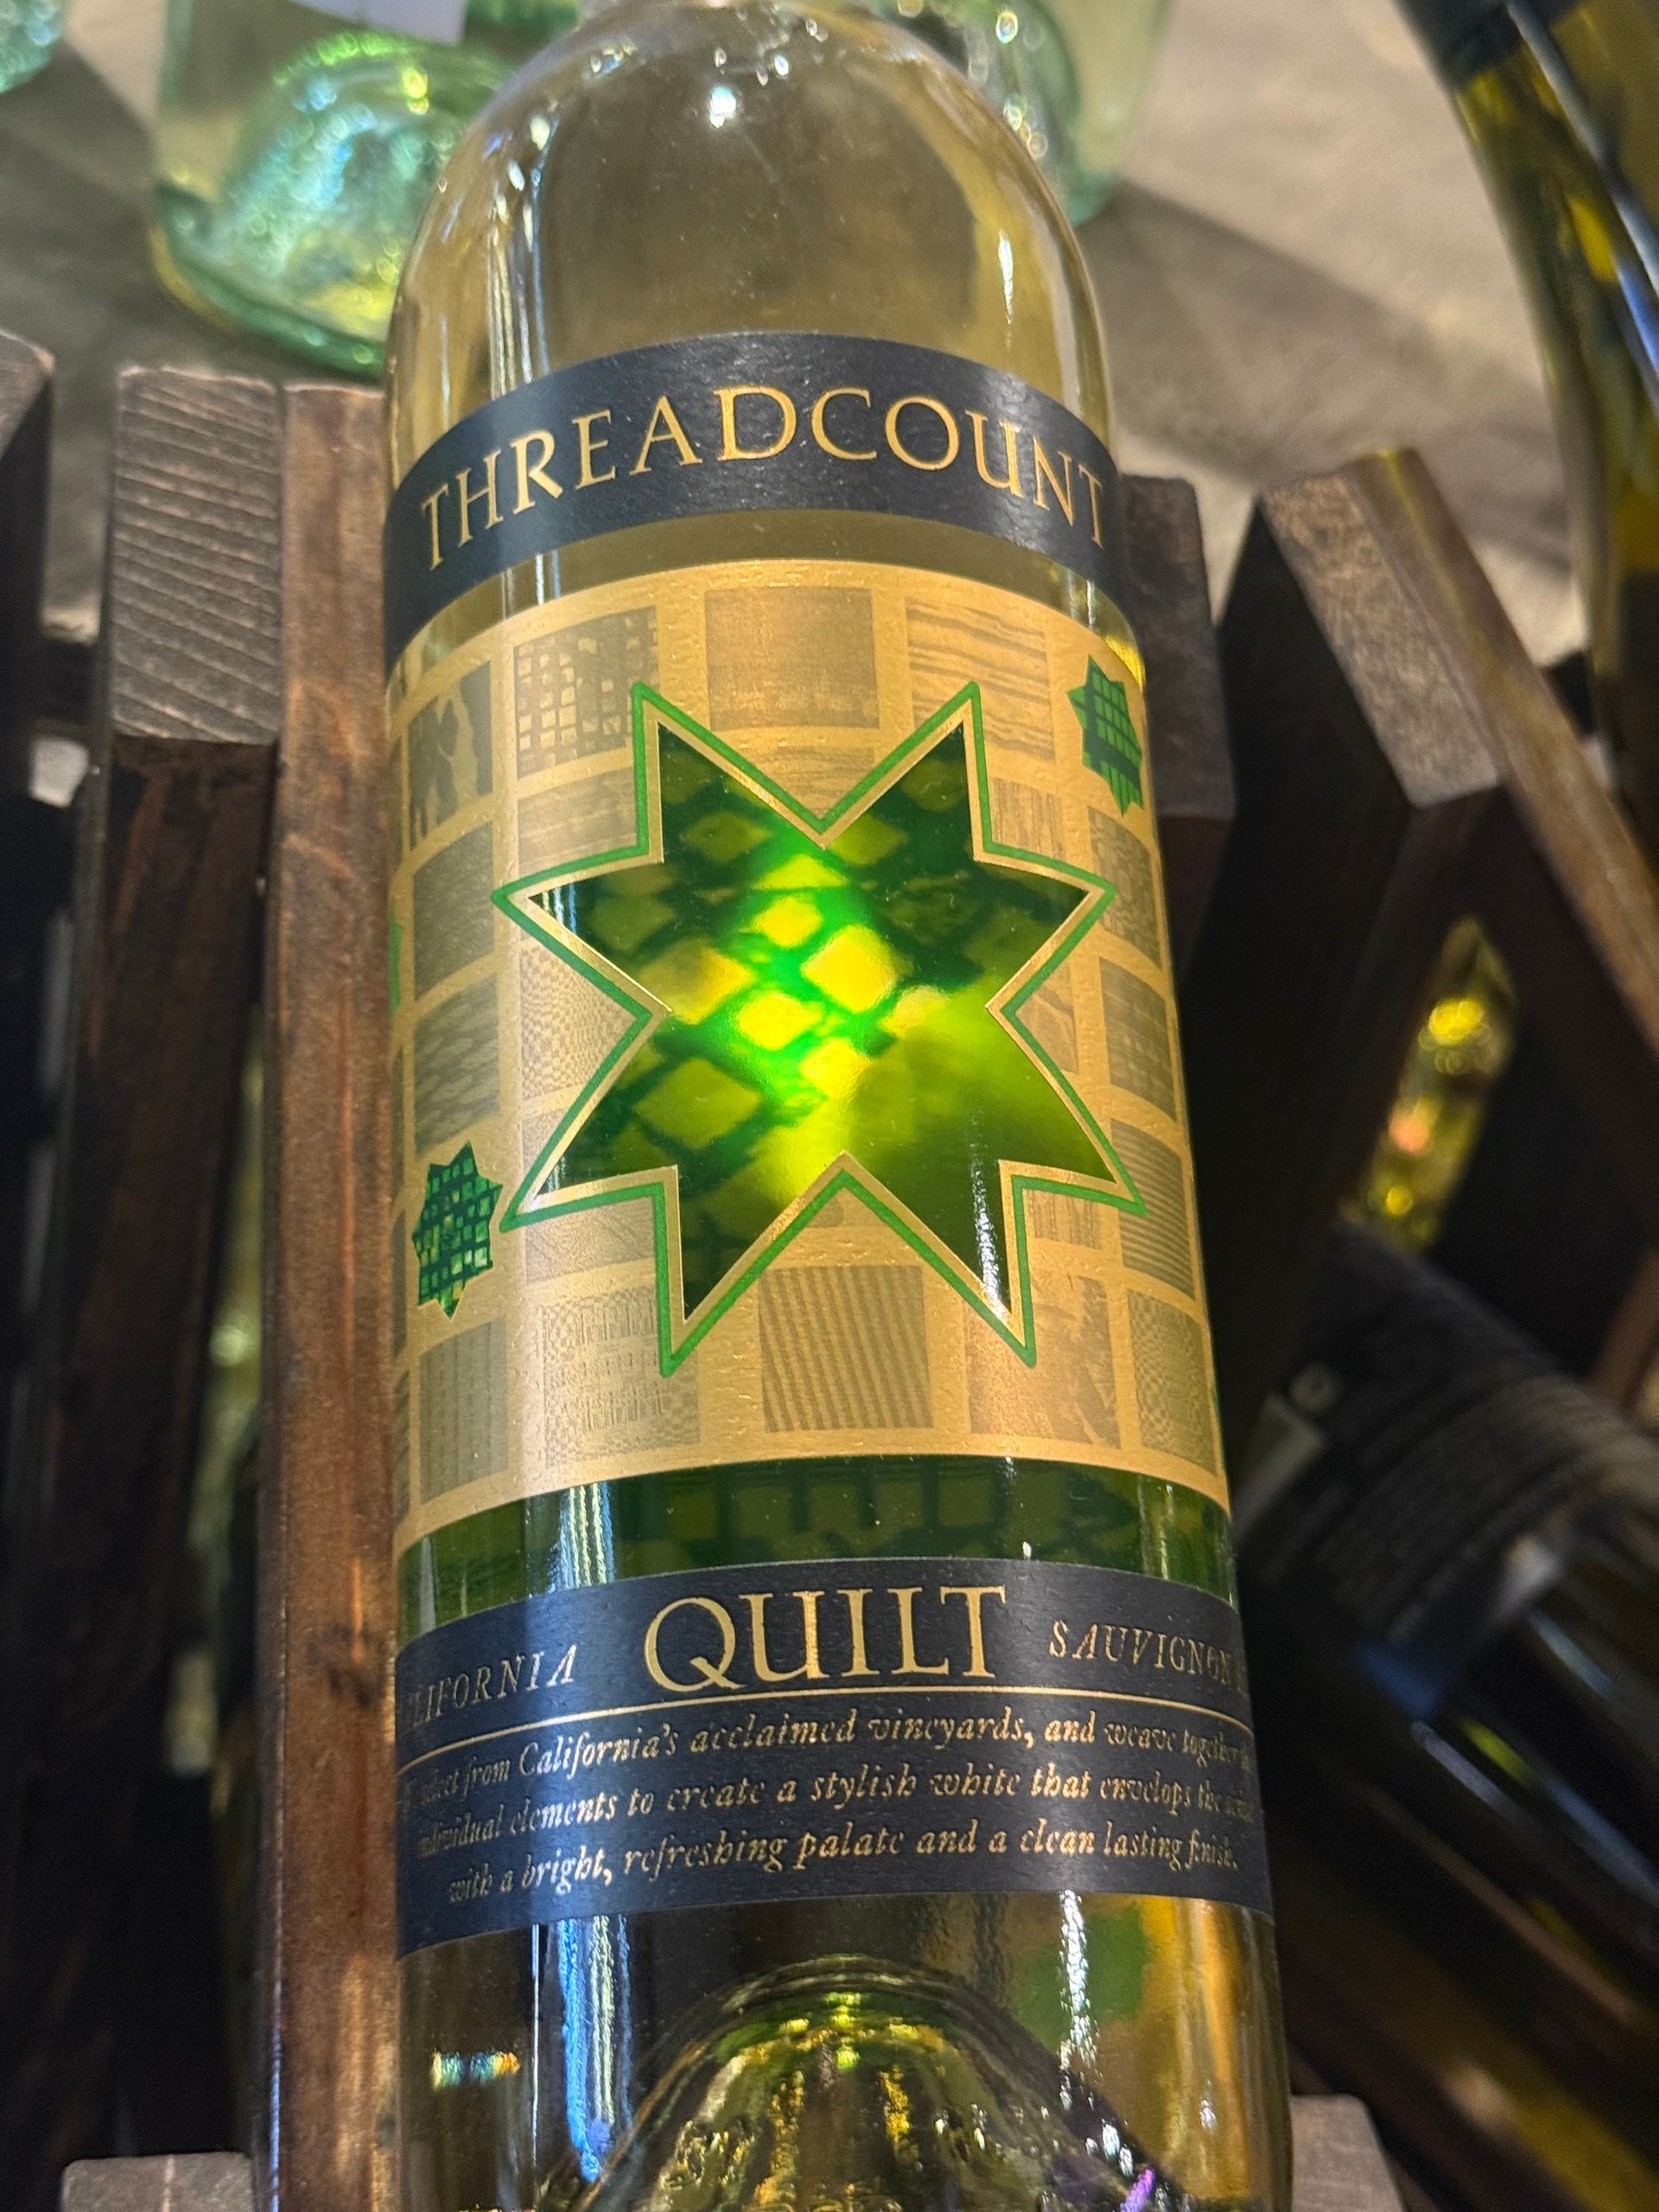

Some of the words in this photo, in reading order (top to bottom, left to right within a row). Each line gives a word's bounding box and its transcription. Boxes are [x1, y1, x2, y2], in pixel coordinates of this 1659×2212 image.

[420, 384, 1106, 571] THREADCOUNT
[398, 1643, 577, 1729] LIFORNIA
[643, 1584, 1007, 1693] QUILT
[1048, 1618, 1231, 1685] SAUVIGNON
[461, 1755, 511, 1802] from
[518, 1722, 678, 1781] California's
[690, 1707, 858, 1753] acclaimed
[868, 1706, 1035, 1751] vineyards,
[1044, 1709, 1097, 1744] and
[1103, 1722, 1178, 1753] weave
[509, 1792, 619, 1835] elements
[626, 1787, 655, 1816] to
[665, 1777, 766, 1812] create
[777, 1779, 798, 1803] a
[810, 1762, 918, 1810] stylish
[929, 1761, 1021, 1798] white
[1029, 1761, 1093, 1800] that
[1099, 1770, 1192, 1817] envelops
[448, 1862, 494, 1903] with
[499, 1868, 514, 1893] a
[520, 1844, 613, 1896] bright,
[623, 1828, 789, 1883] refreshing
[791, 1821, 905, 1871] palate
[916, 1818, 979, 1854] and
[988, 1829, 1007, 1853] a
[1019, 1817, 1096, 1857] clean
[1102, 1820, 1185, 1872] lasting
